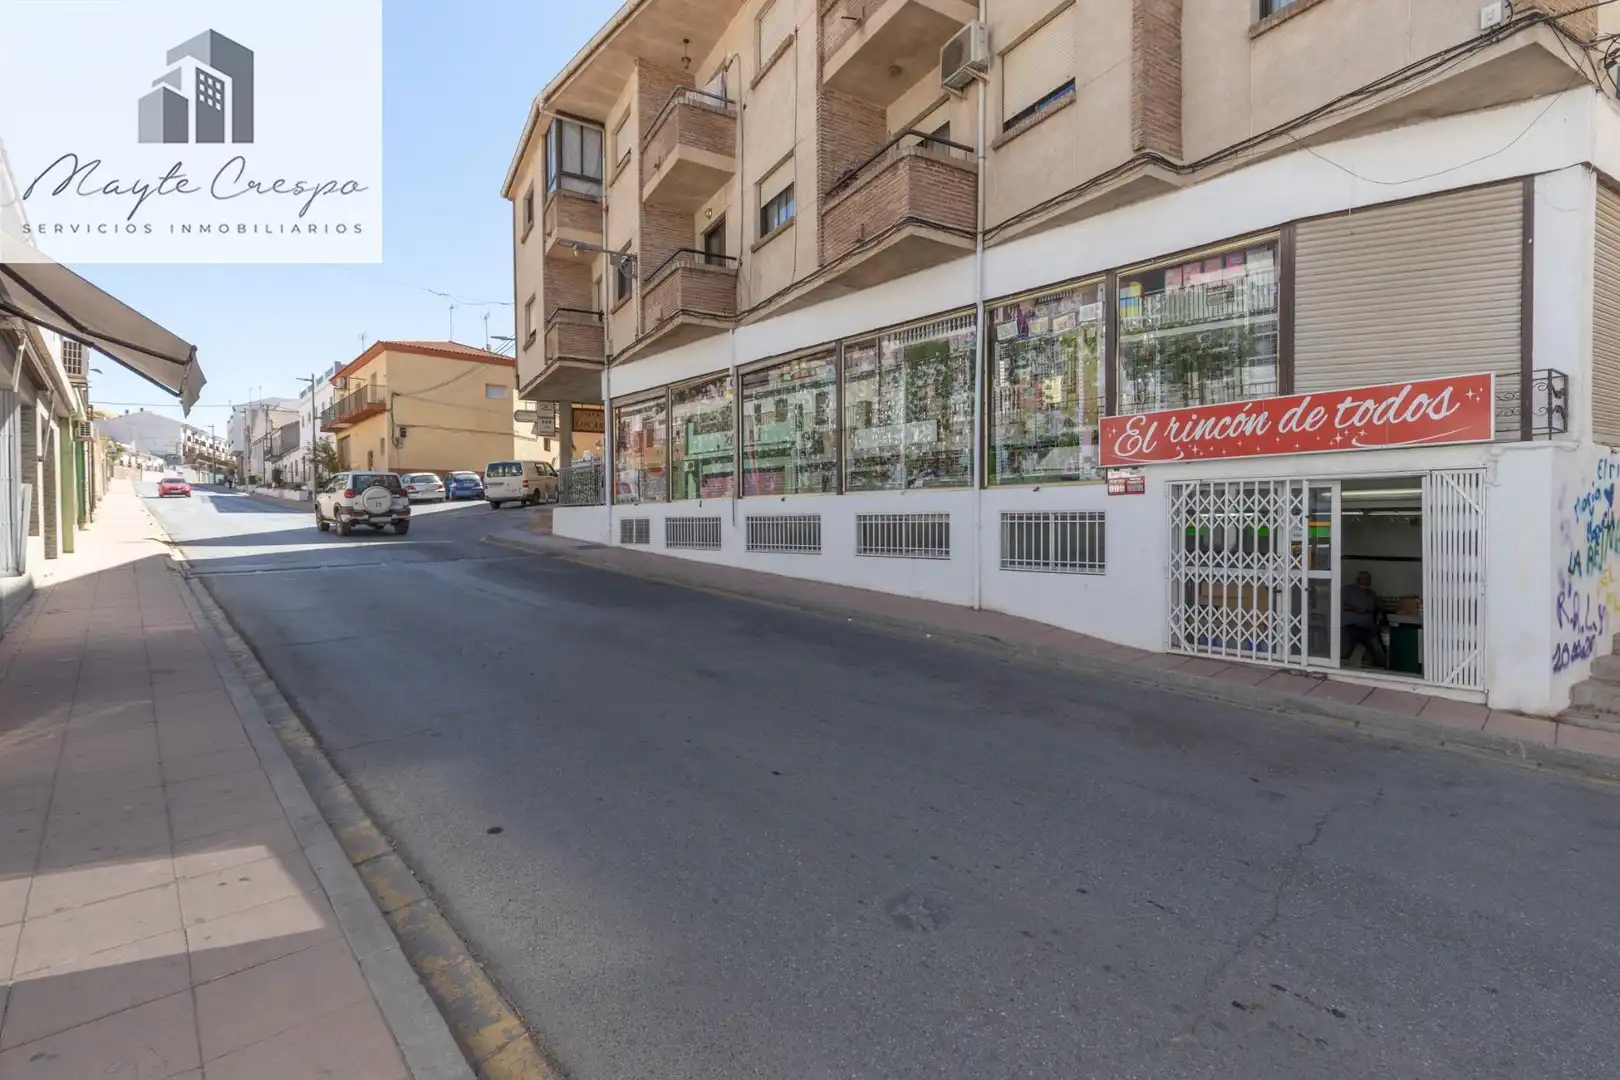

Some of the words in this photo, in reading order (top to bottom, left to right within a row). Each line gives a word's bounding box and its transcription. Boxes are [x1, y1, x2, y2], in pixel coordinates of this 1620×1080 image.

[1113, 414, 1157, 457] El
[1163, 401, 1272, 444] rincón
[1277, 396, 1329, 433] de
[1333, 384, 1461, 428] todos
